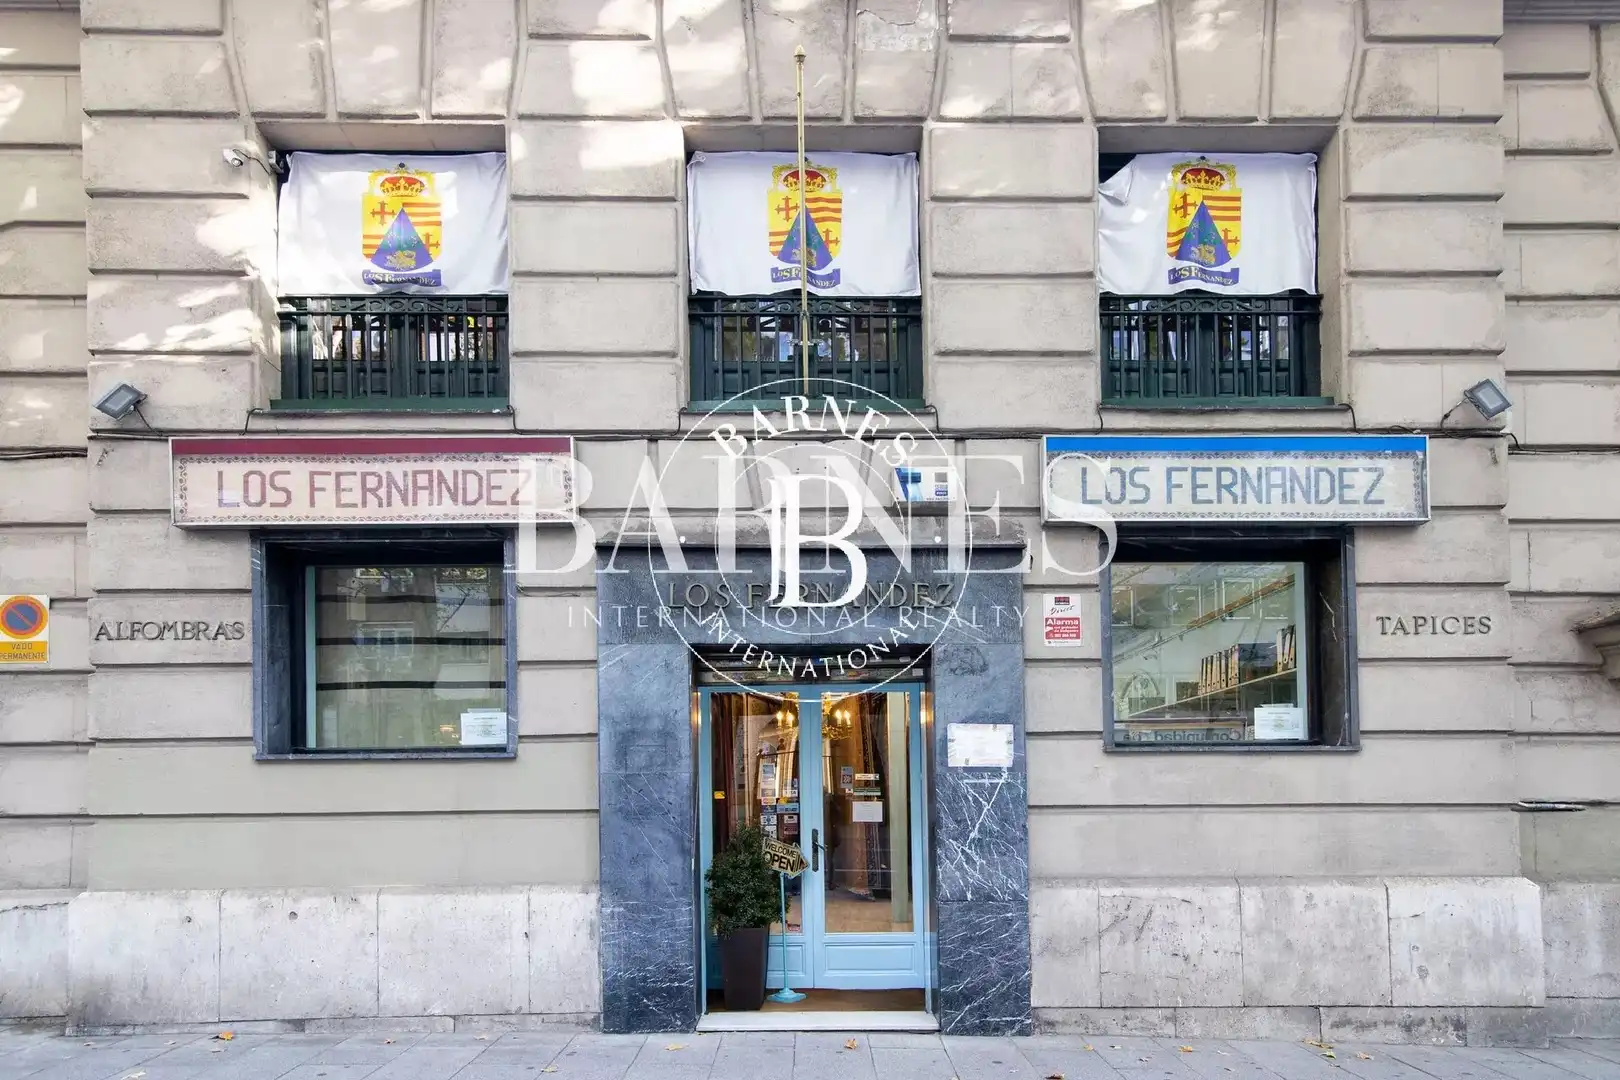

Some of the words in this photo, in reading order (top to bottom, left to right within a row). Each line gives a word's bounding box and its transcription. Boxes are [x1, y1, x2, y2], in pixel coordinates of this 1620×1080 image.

[1169, 267, 1189, 280] LOS
[217, 470, 292, 508] LOS
[309, 469, 532, 507] FERNANDEZ
[1081, 466, 1150, 505] LOS
[1165, 466, 1385, 505] FERNANDEZ
[667, 582, 732, 608] LOS
[746, 581, 954, 608] FERNNDEZ
[94, 621, 246, 641] ALFOMBRAS
[1375, 615, 1492, 636] TAPICES
[11, 642, 33, 650] VADO
[765, 841, 797, 859] WELCOME
[764, 850, 796, 873] OPEN
